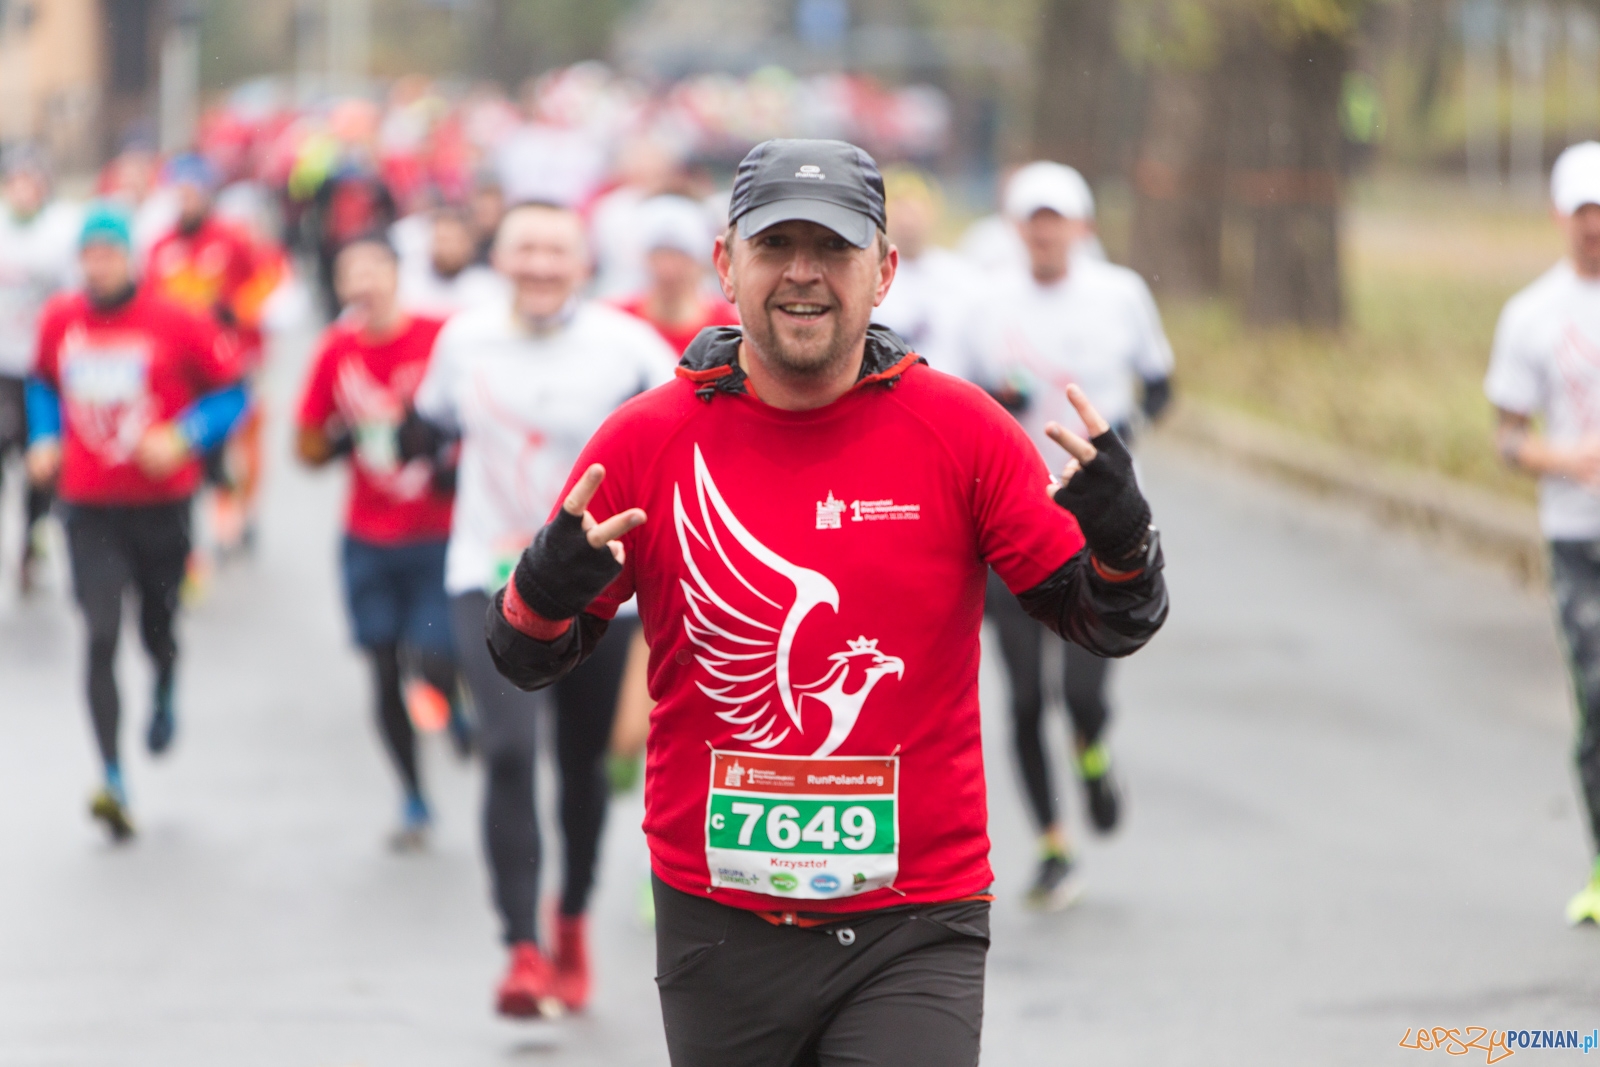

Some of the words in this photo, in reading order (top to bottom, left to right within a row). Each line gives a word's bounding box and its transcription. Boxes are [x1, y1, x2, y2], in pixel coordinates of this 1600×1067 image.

[849, 499, 864, 522] 1
[807, 774, 884, 787] RunPoland.org
[731, 801, 876, 851] 7649
[770, 857, 828, 870] Krzysztof
